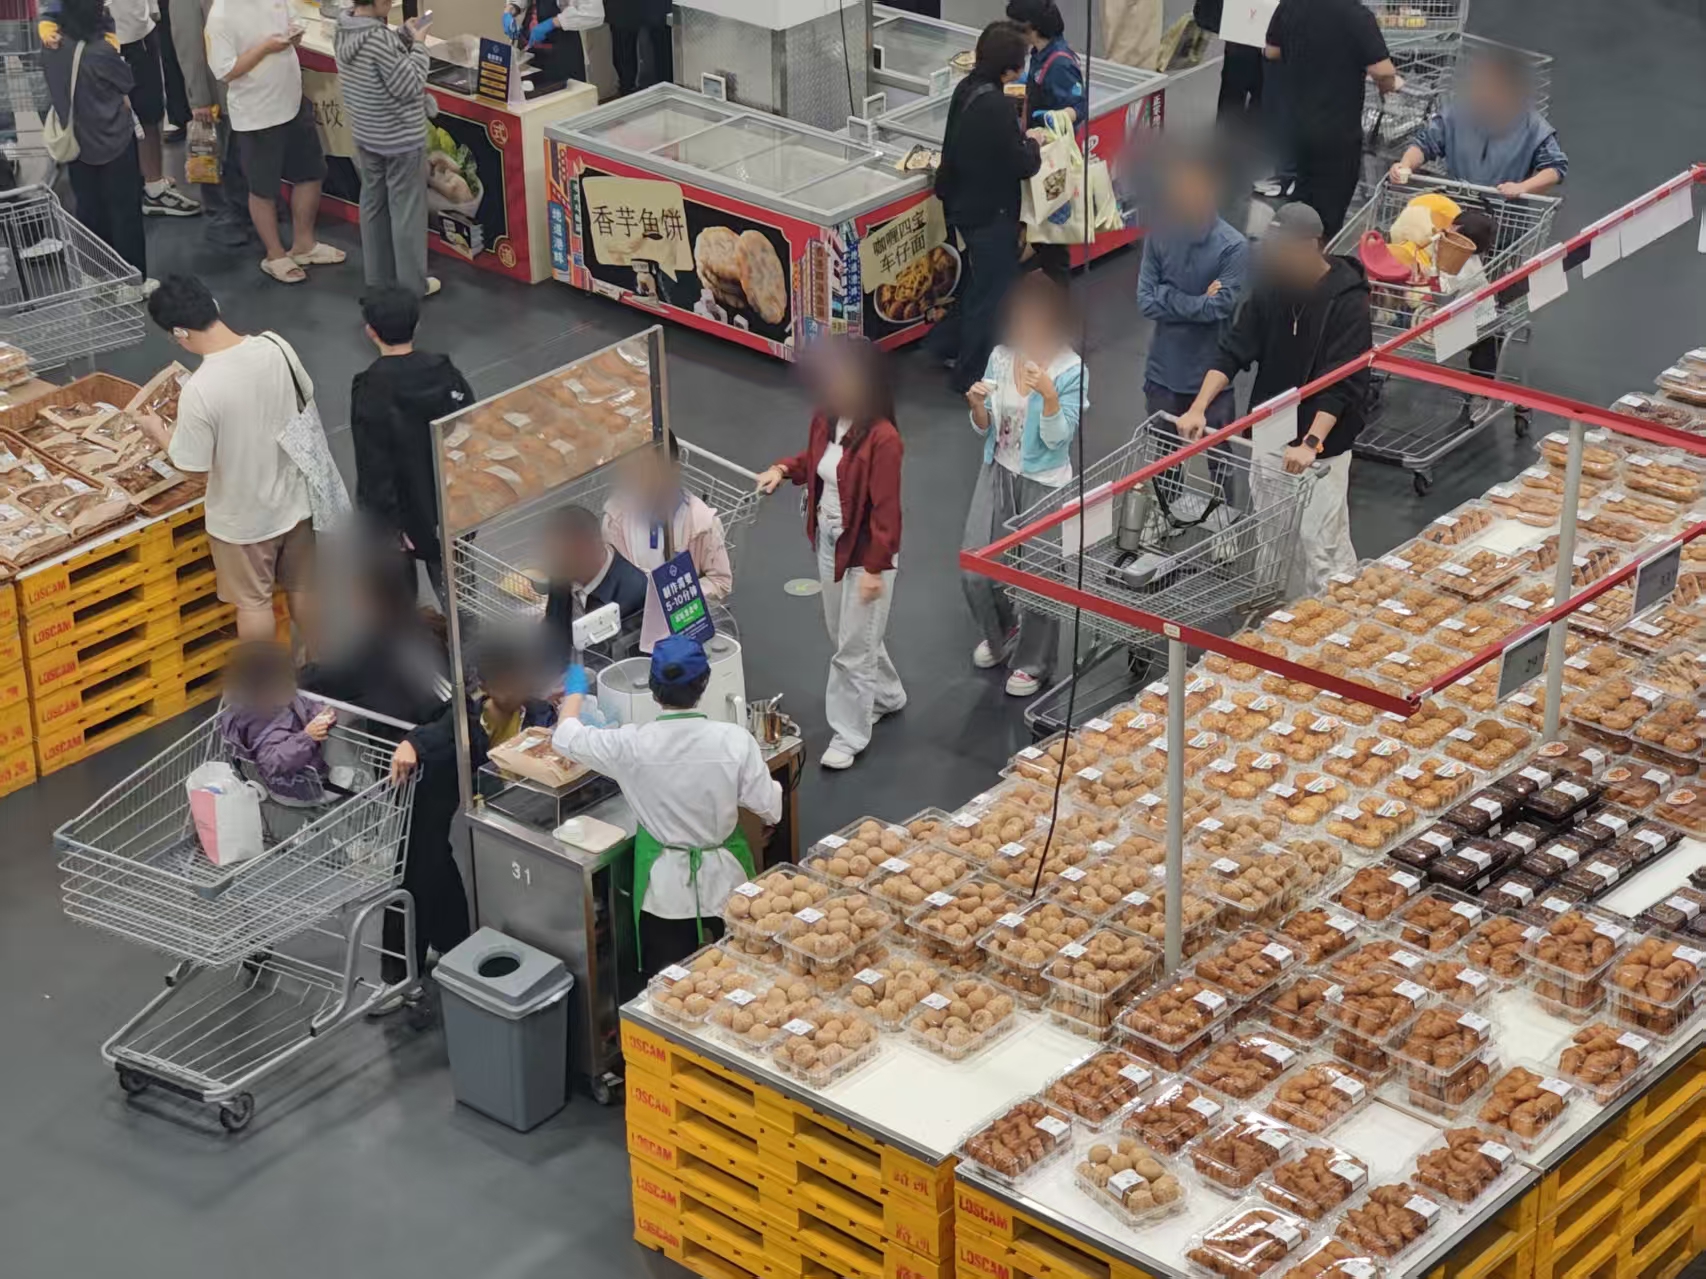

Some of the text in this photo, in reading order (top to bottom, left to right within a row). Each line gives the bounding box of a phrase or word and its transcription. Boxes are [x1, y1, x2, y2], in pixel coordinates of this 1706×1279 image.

[592, 205, 684, 241] 香芋鱼饼
[880, 229, 925, 273] 车仔面
[29, 578, 67, 604] LOSCAM
[33, 618, 72, 645] LOSCAM
[38, 663, 76, 686] LOSCAM
[42, 699, 80, 724] LOSCAM
[44, 734, 82, 760] LOSCAM
[511, 861, 531, 885] 31
[636, 1176, 677, 1208] LOSCAM
[959, 1195, 1008, 1230] LOSCAM
[638, 1216, 680, 1248] LOSCAM
[960, 1247, 1010, 1279] LOSCAM
